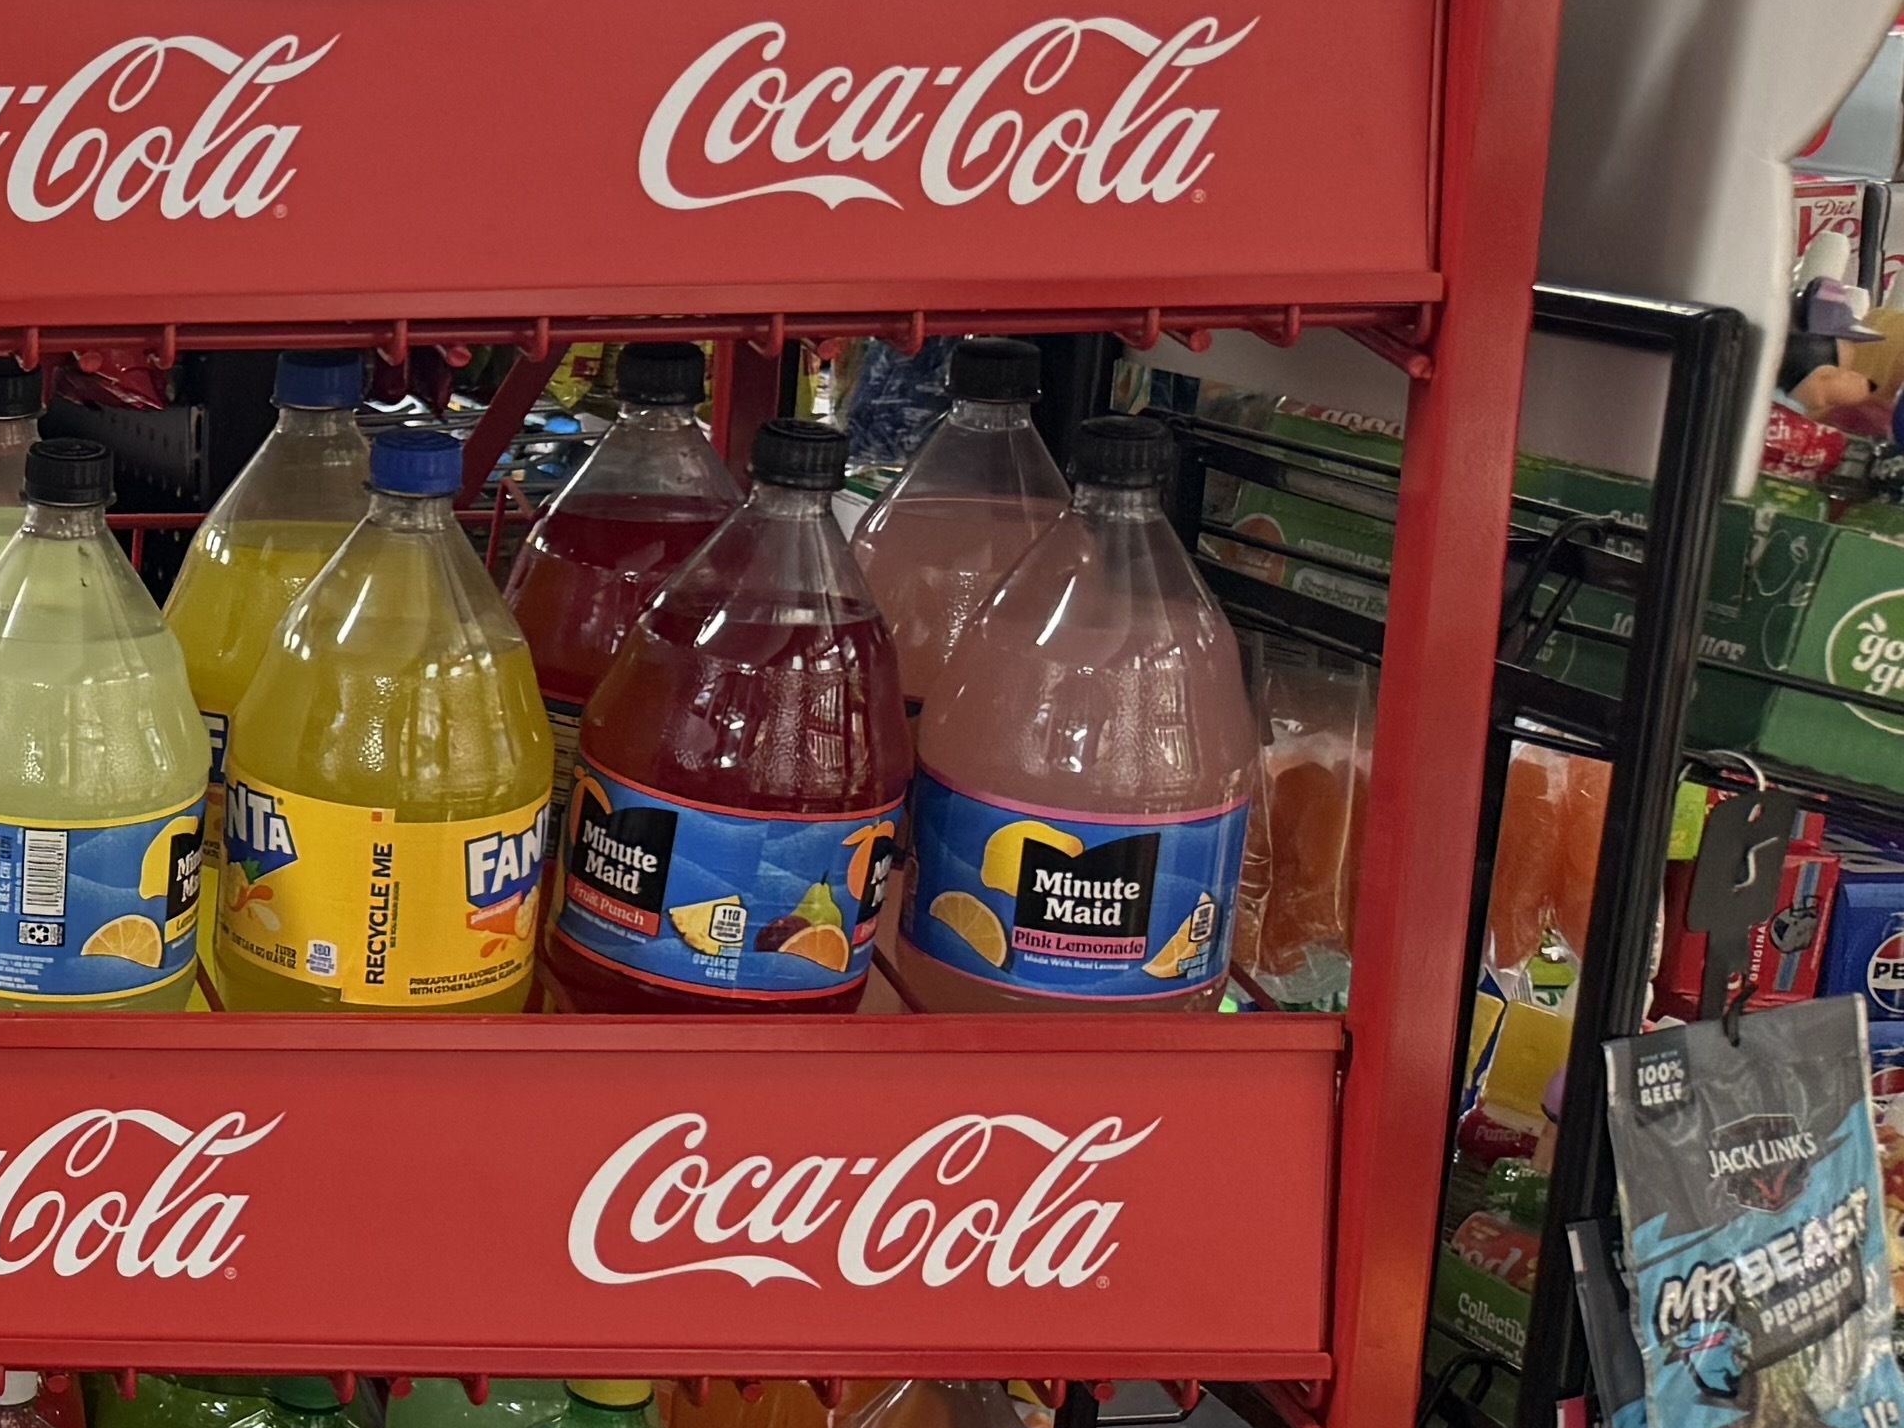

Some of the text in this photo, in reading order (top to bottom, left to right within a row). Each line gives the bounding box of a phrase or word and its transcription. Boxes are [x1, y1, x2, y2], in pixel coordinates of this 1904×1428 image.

[639, 15, 1260, 210] Coca-Cola
[373, 842, 392, 878] ME
[582, 821, 659, 874] Minute
[584, 850, 642, 895] Maid
[1032, 869, 1142, 906] Minute
[572, 882, 600, 910] Fruit
[599, 895, 646, 927] Punch
[1044, 894, 1123, 930] Maid
[365, 881, 391, 985] RECYCLE
[1012, 930, 1146, 959] Pink Lemonade
[1637, 1059, 1685, 1088] 100%
[1641, 1082, 1684, 1108] BEEF
[1708, 1131, 1819, 1180] JACK LINK'S
[568, 1113, 1163, 1289] Coca-Cola
[1760, 1266, 1855, 1334] PEPPERED
